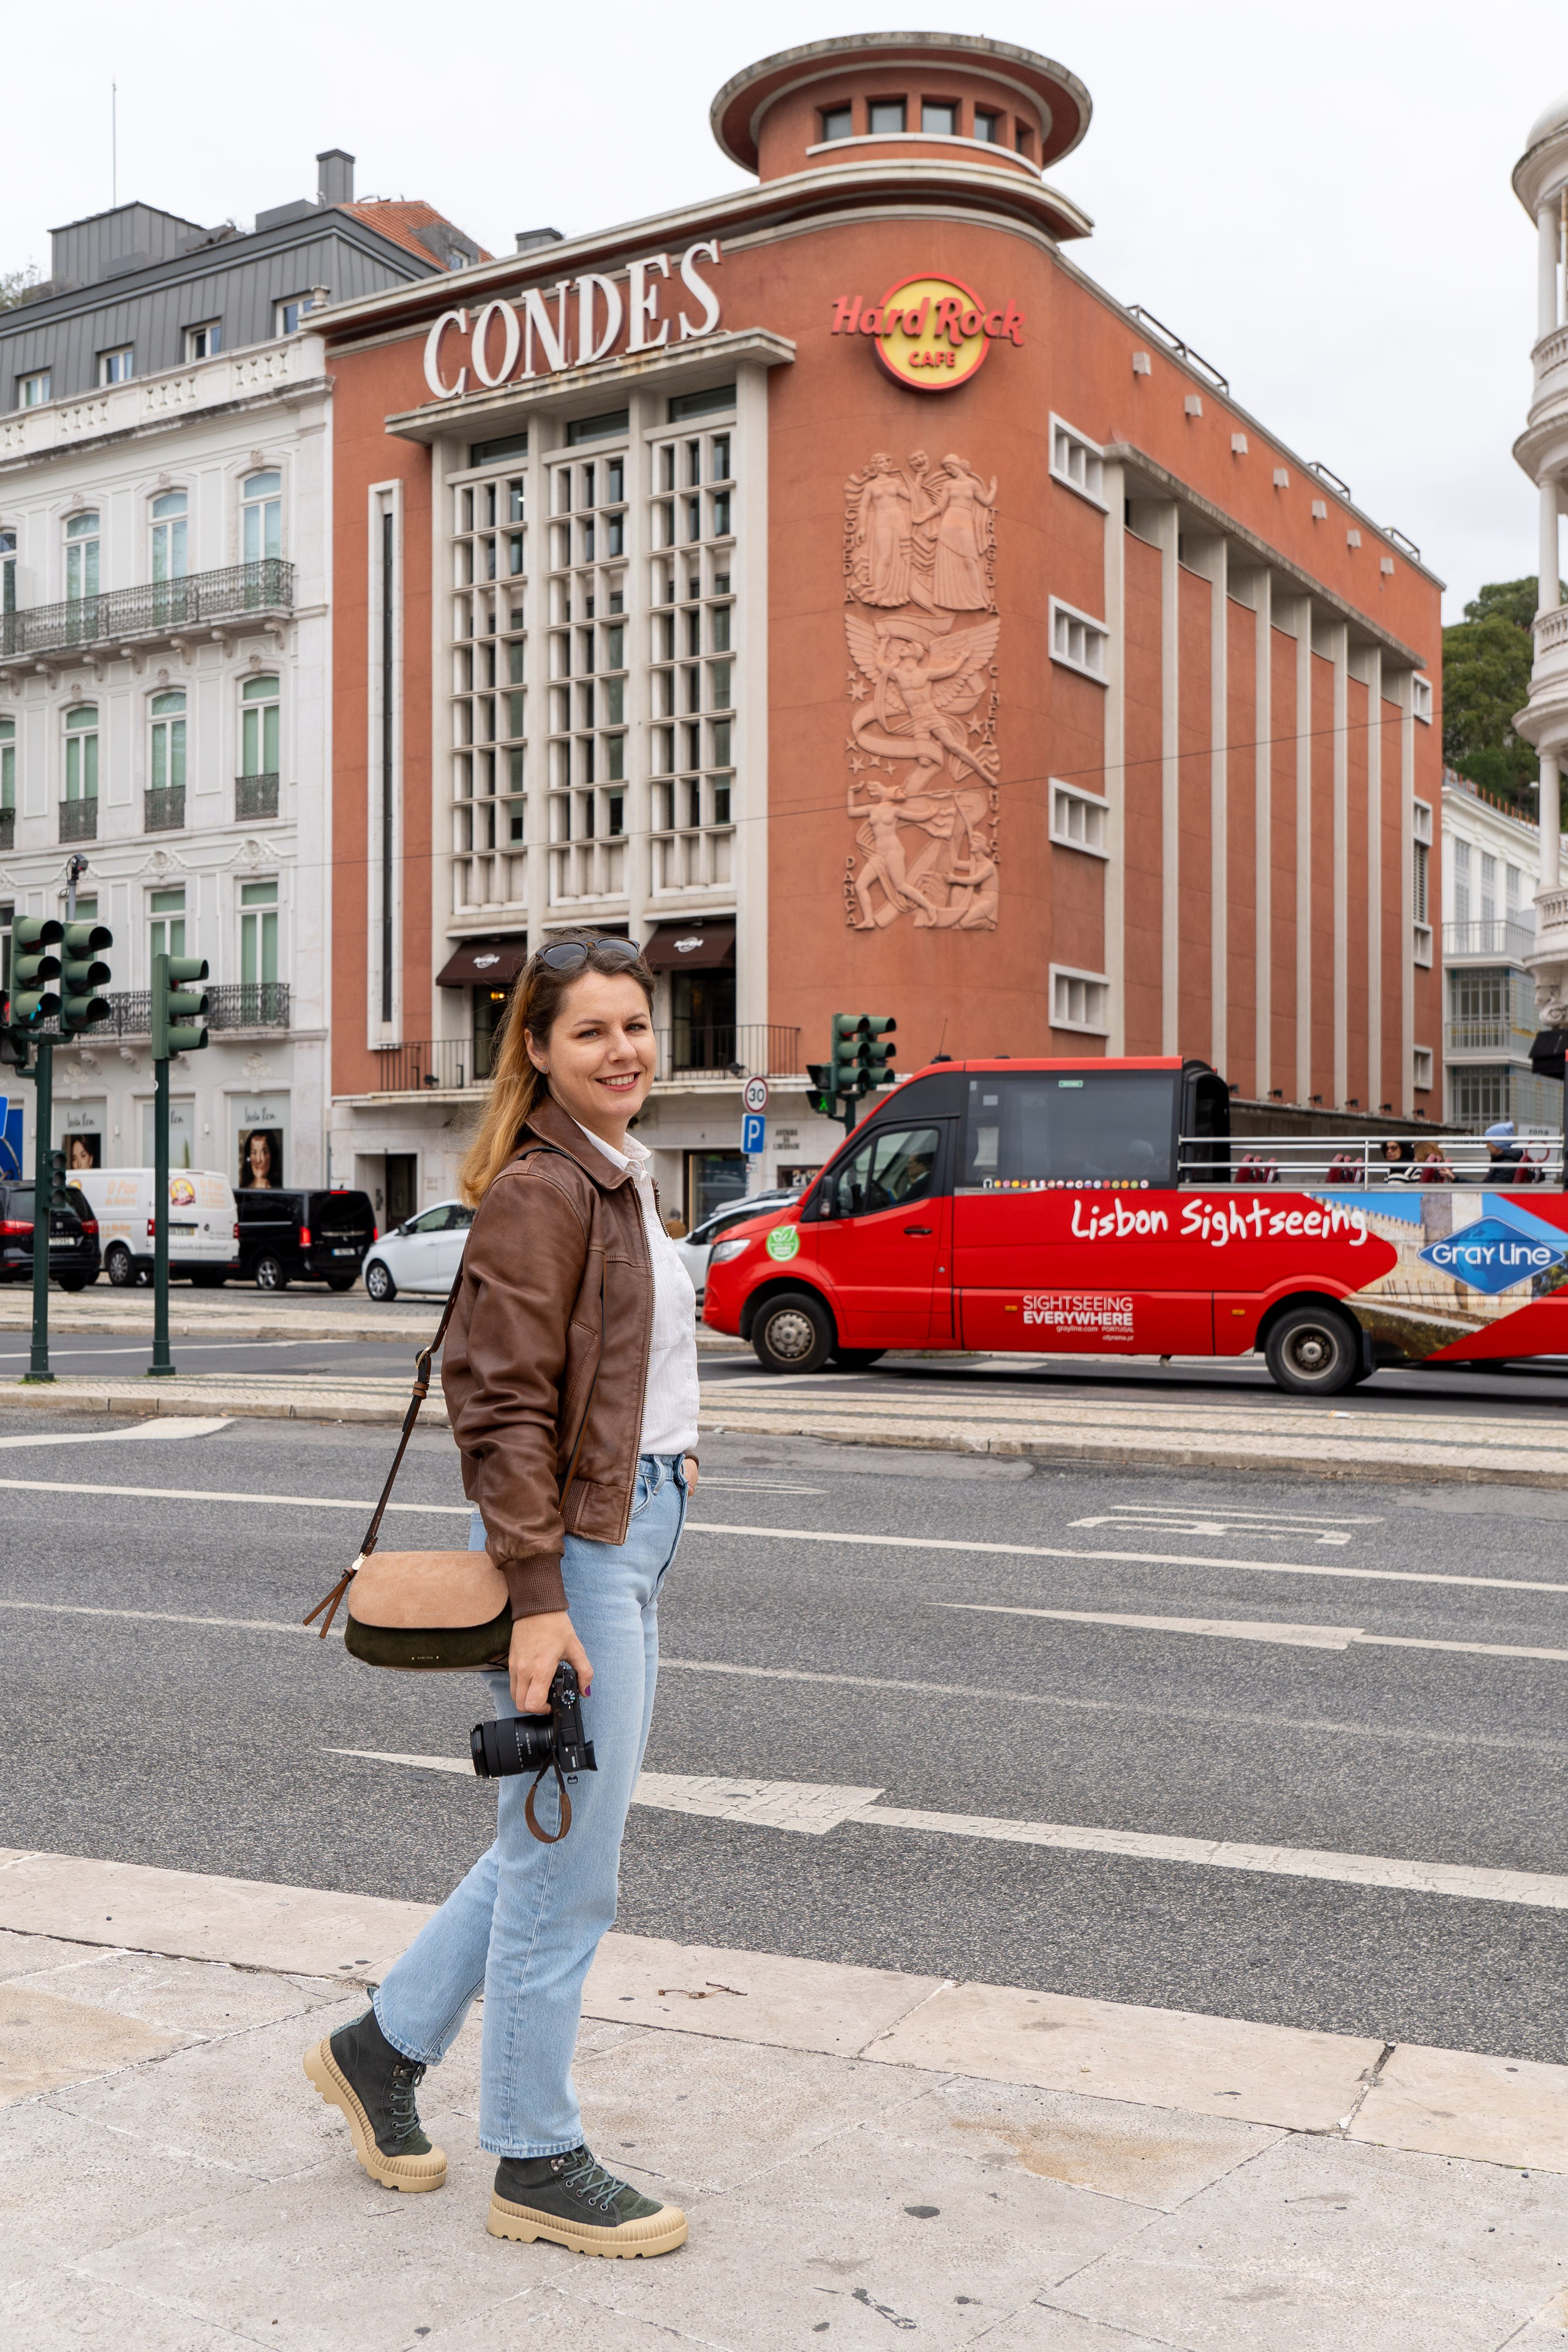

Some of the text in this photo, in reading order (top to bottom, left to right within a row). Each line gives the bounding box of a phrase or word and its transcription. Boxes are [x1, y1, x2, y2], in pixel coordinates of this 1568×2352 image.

[423, 239, 722, 399] CONDES
[831, 295, 1027, 346] Hard Rock
[908, 351, 956, 368] CAFE
[982, 665, 1000, 745] CINEMA
[843, 855, 857, 927] DANÇA
[748, 1088, 764, 1102] 30
[747, 1119, 761, 1149] P
[1071, 1197, 1368, 1247] Lisbon Sightseeing
[1432, 1242, 1551, 1265] Gray Line
[1023, 1295, 1133, 1312] SIGHTSEEING
[1023, 1310, 1133, 1326] EVERYWHERE
